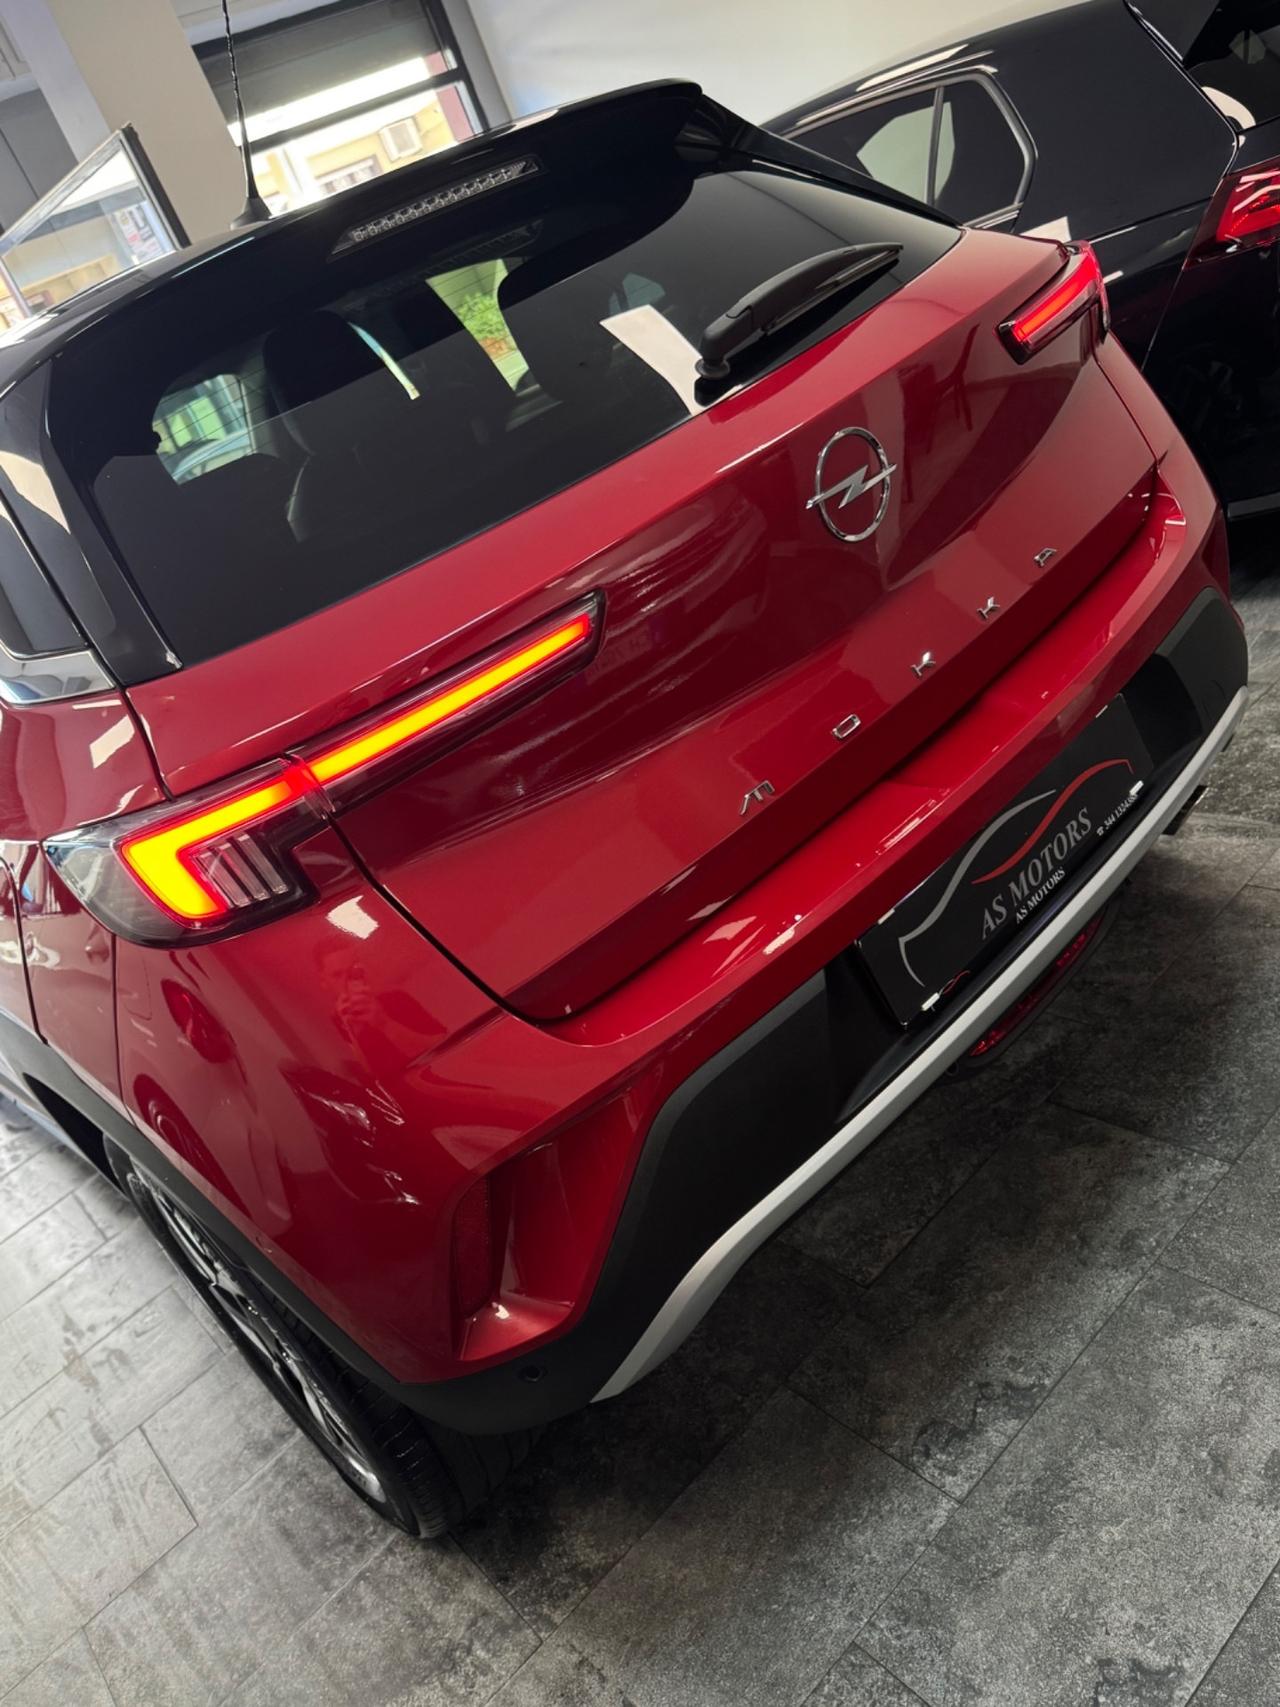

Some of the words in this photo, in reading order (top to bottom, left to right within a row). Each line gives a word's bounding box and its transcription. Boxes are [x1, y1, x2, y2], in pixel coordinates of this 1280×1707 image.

[739, 547, 1057, 815] MOKKA
[982, 894, 1008, 940] AS
[1008, 807, 1092, 907] MOTORS
[1015, 905, 1028, 924] AS
[1028, 867, 1066, 911] MOTORS
